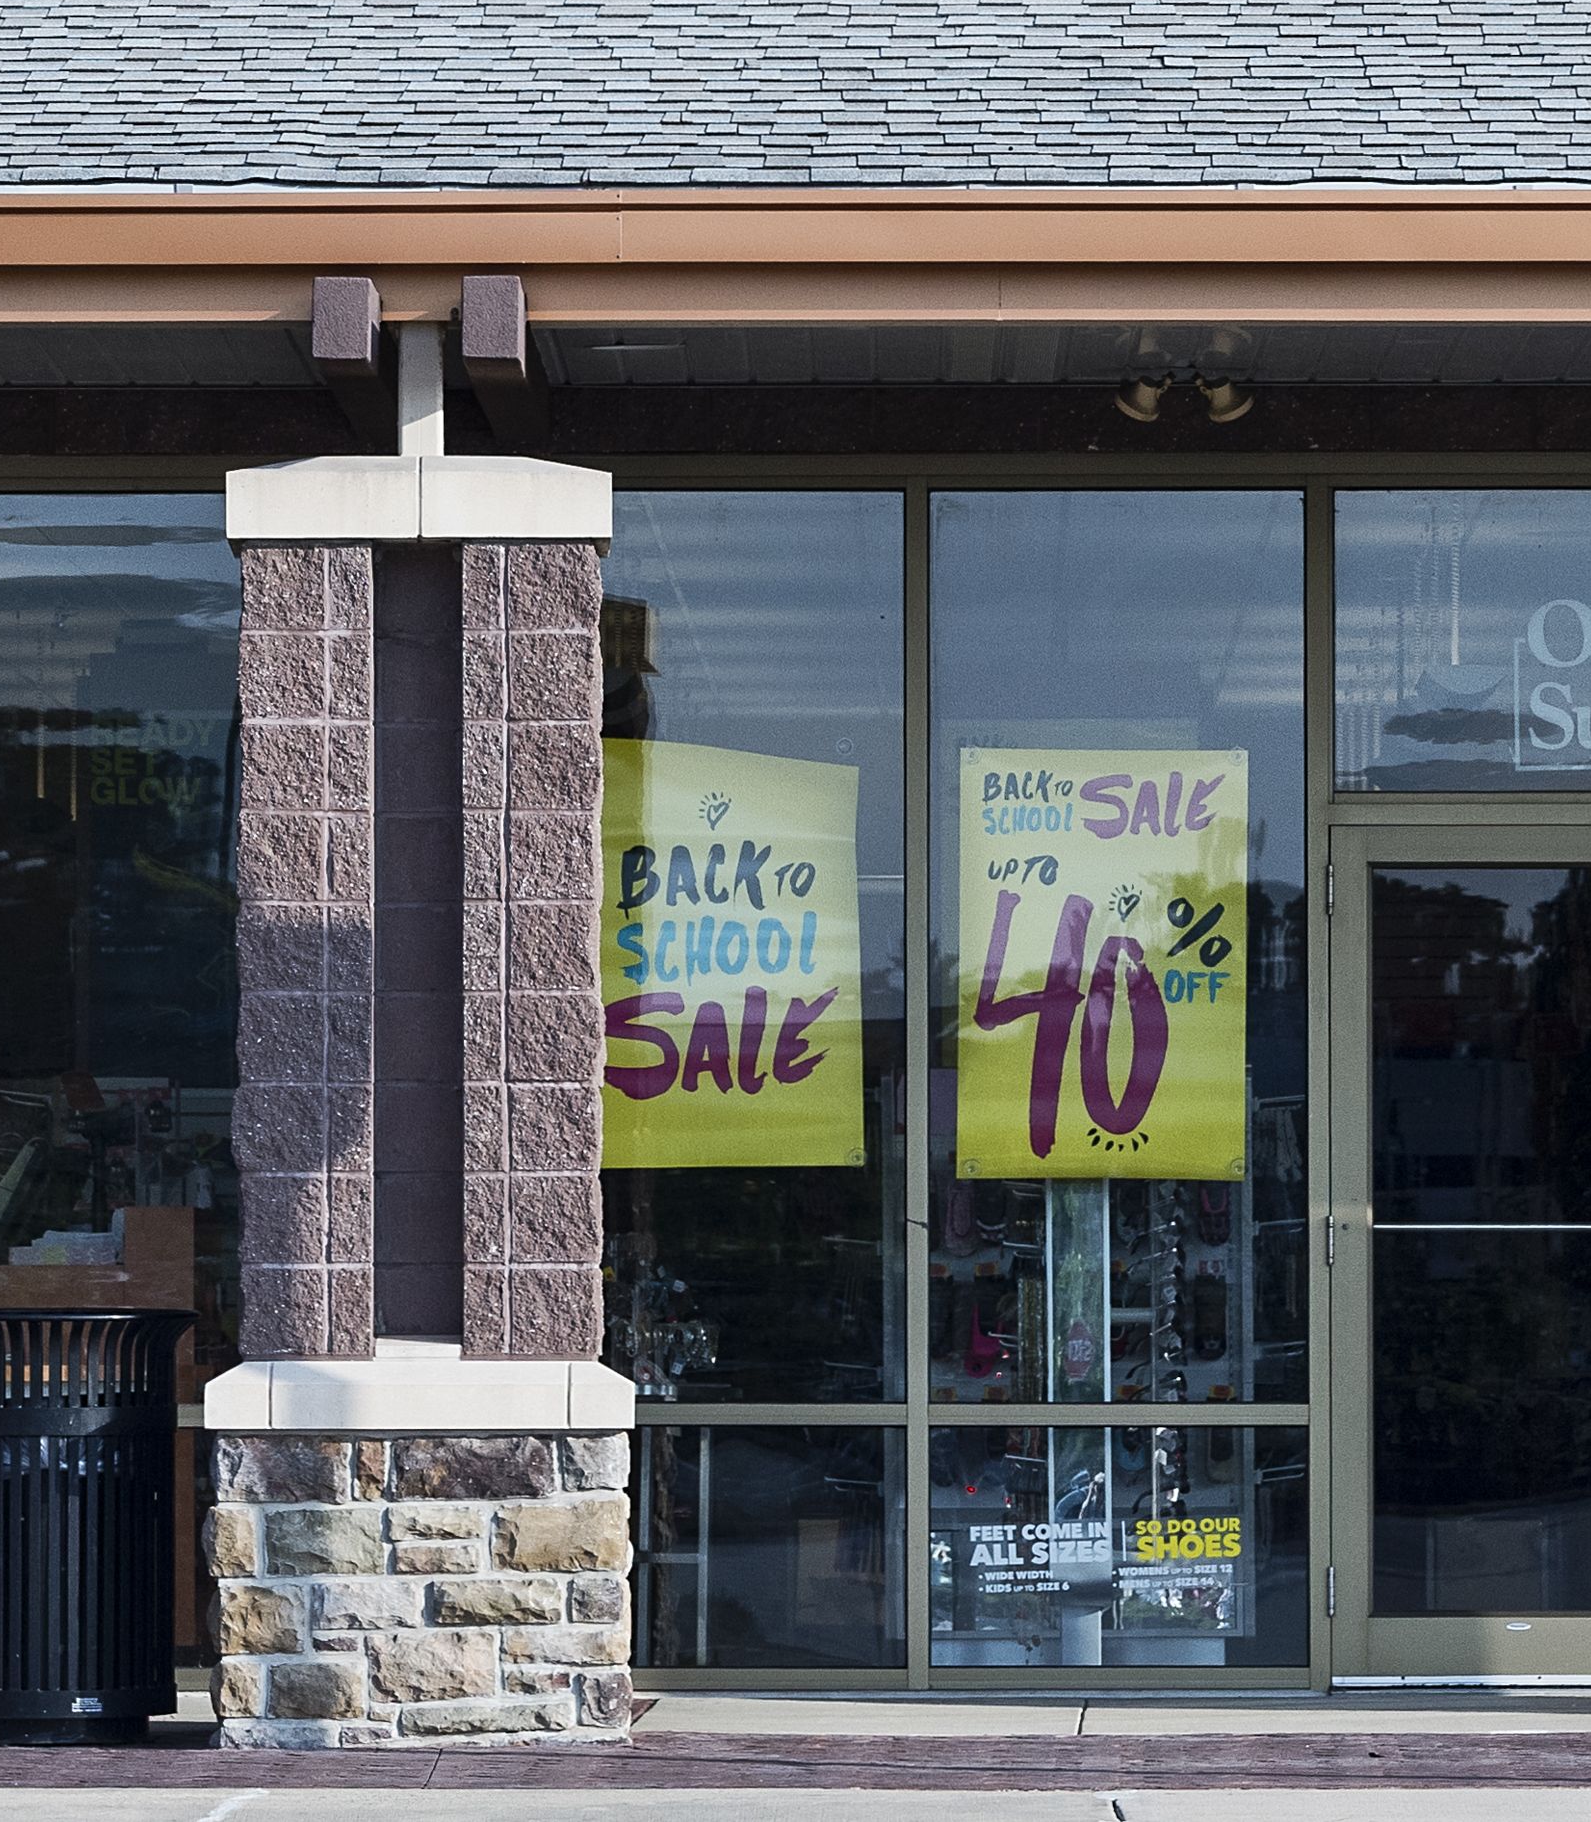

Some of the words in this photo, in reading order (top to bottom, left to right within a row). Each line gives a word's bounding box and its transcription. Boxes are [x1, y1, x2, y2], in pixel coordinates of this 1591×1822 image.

[90, 748, 161, 776] SET
[90, 776, 201, 805] GLOW
[982, 770, 1053, 805] BACK
[1054, 780, 1073, 796] TO
[982, 802, 1073, 835] SCHOOL
[1079, 771, 1225, 839] SALE
[617, 840, 771, 916] BACK
[775, 861, 816, 897] TO
[988, 858, 1018, 882] UP
[1021, 855, 1059, 886] TO
[617, 911, 817, 985] SCHOOL
[1164, 969, 1231, 1003] OFF
[603, 985, 839, 1100] SALE
[969, 1524, 1017, 1542] FEET
[1021, 1523, 1083, 1540] COME
[1088, 1522, 1109, 1538] IN
[1135, 1520, 1162, 1535] SO
[1167, 1519, 1197, 1533] DO
[1200, 1517, 1240, 1533] OUR
[969, 1543, 1024, 1566] ALL
[1030, 1539, 1109, 1564] SIZES
[1136, 1533, 1241, 1563] SHOES
[984, 1570, 1014, 1581] WIDE
[1016, 1570, 1054, 1580] WIDTH
[1118, 1566, 1169, 1576] WOMENS
[1171, 1567, 1181, 1575] UP
[1194, 1564, 1218, 1574] SIZE
[1219, 1564, 1233, 1573] 12
[1118, 1579, 1150, 1589] MENS
[1175, 1577, 1198, 1587] SIZE
[985, 1584, 1012, 1593] KIDS
[1025, 1584, 1035, 1592] TO
[1036, 1582, 1060, 1592] SIZE
[1062, 1582, 1070, 1591] 6
